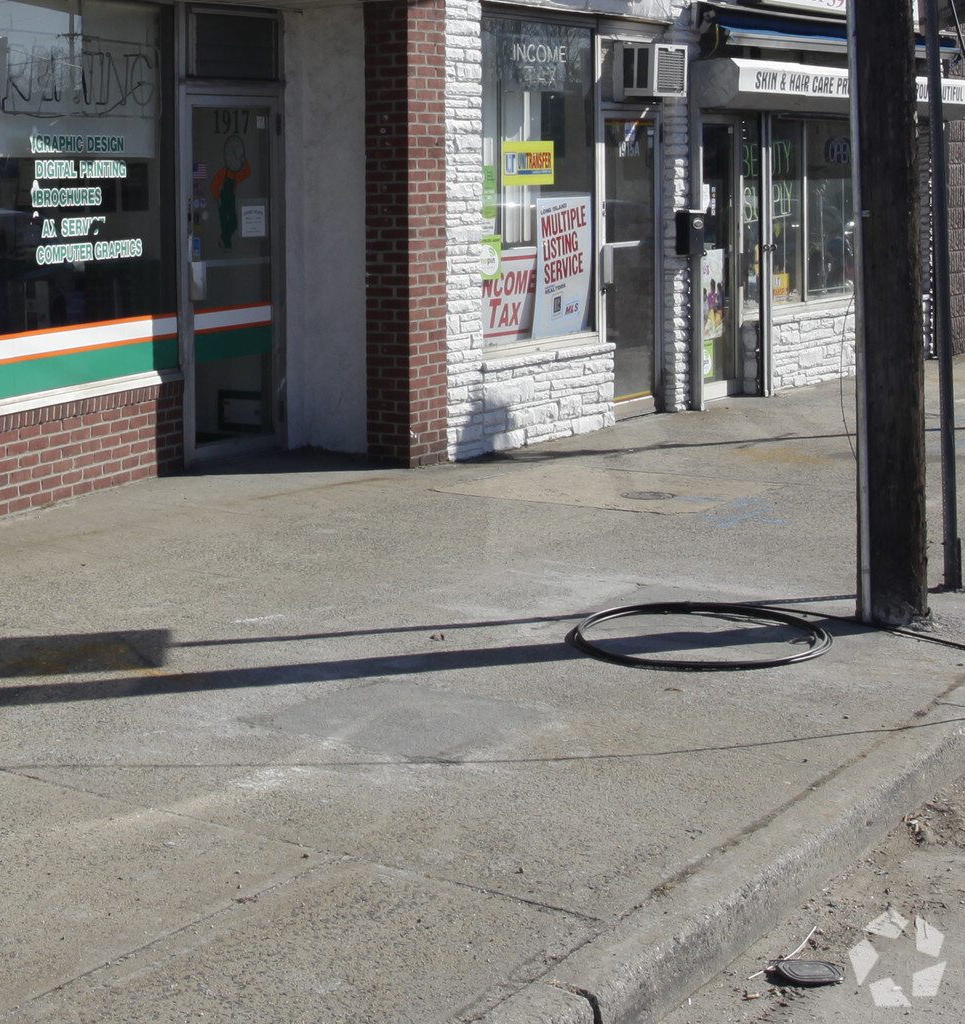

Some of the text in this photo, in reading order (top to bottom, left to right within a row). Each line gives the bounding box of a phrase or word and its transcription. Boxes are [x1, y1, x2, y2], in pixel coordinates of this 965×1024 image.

[511, 43, 567, 63] INCOME
[755, 71, 777, 90] SKIN
[780, 73, 786, 91] &
[789, 74, 810, 93] HAIR
[812, 76, 835, 94] CARE
[213, 109, 250, 135] 1917
[35, 135, 124, 153] GRAPHIC DESIGN
[35, 160, 127, 179] DIGITAL PRINTING
[36, 187, 102, 208] BROCHURES
[540, 207, 552, 215] LONG
[541, 205, 587, 239] MULTIPLE
[36, 239, 142, 265] COMPUTER GRAPHICS
[543, 231, 579, 262] LISTING
[544, 252, 584, 285] SERVICE
[544, 283, 566, 295] REALTORS
[489, 298, 523, 329] TAX
[565, 302, 579, 316] MLS
